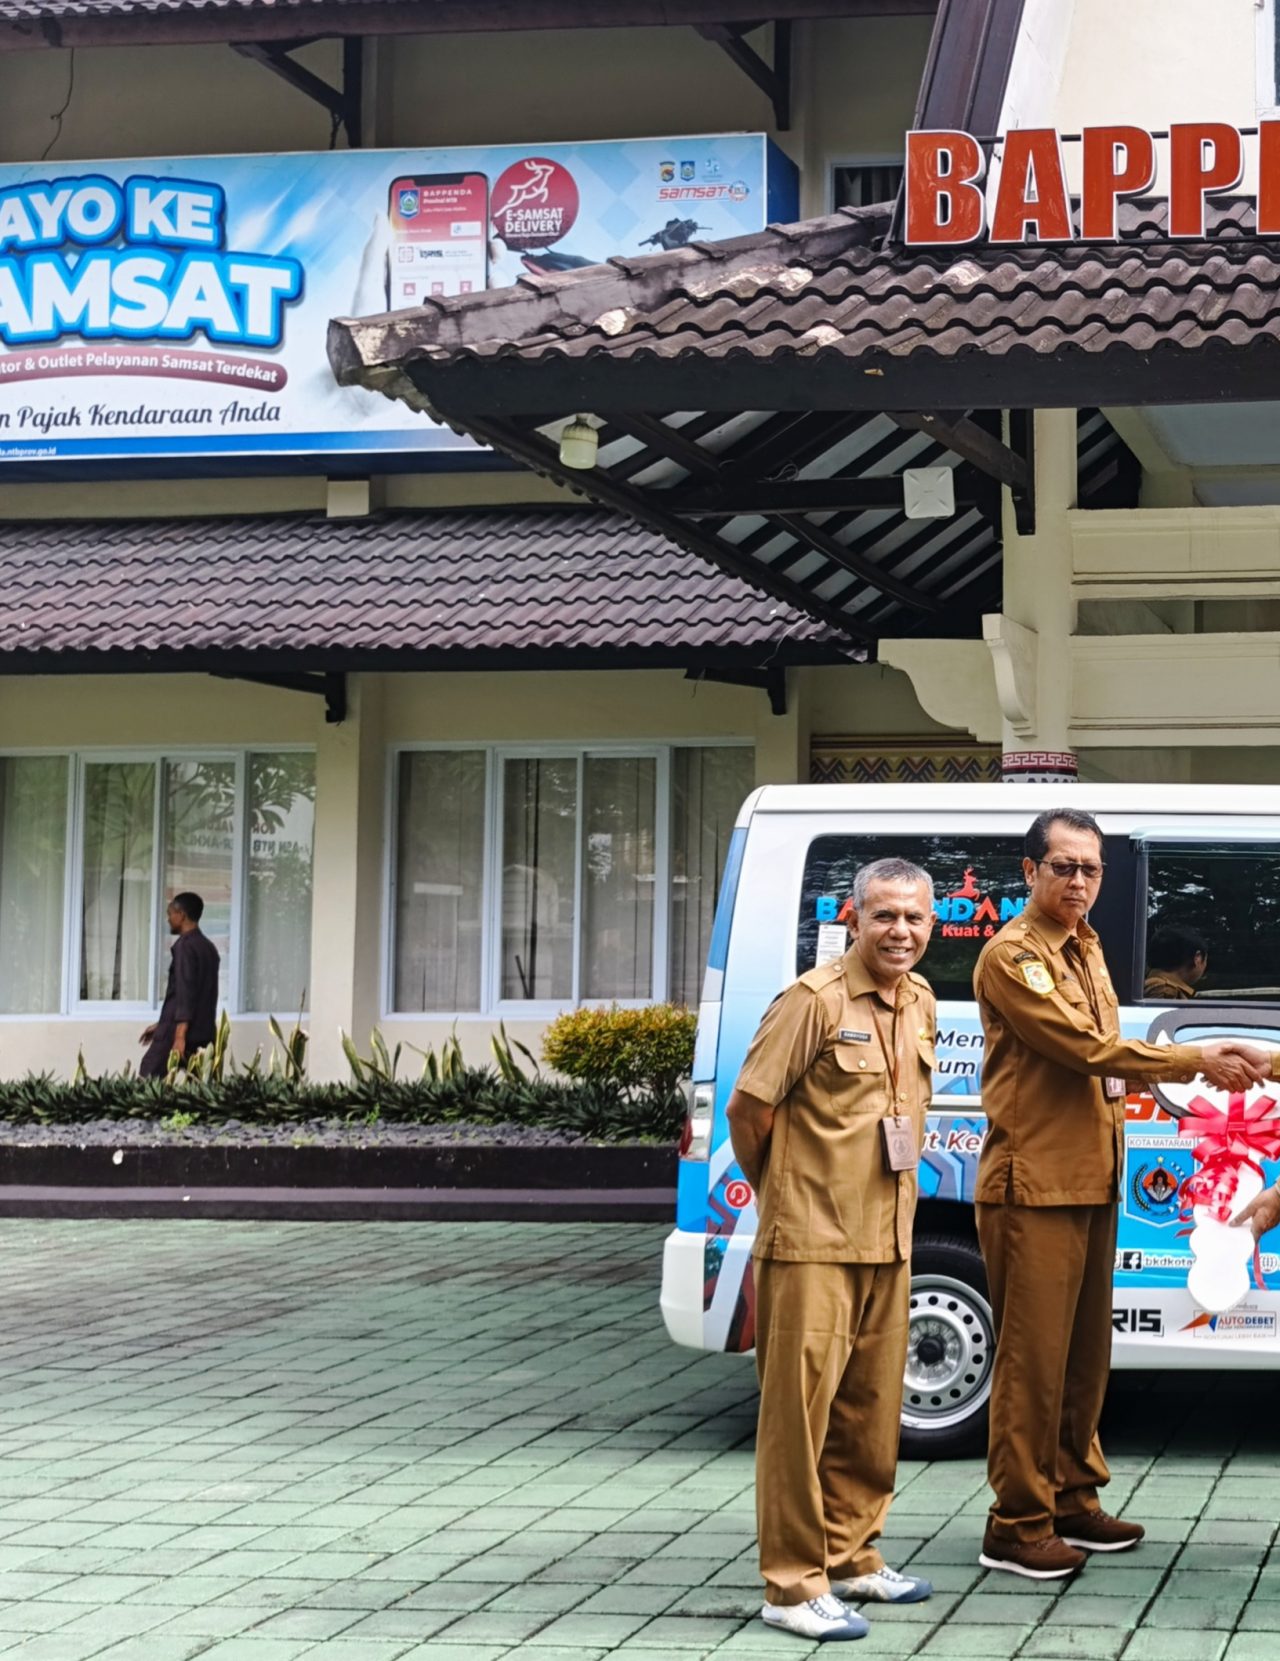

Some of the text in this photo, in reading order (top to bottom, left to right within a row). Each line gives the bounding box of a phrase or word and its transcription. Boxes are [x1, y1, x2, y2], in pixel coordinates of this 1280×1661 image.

[423, 188, 473, 197] BAPPENDA
[0, 186, 214, 243] AYO KE
[506, 207, 564, 221] E-SAMSAT
[504, 219, 563, 233] DELIVERY
[24, 358, 36, 371] &
[38, 354, 83, 369] Outlet
[86, 352, 159, 369] Pelayanan
[161, 354, 213, 373] Samsat
[215, 360, 278, 384] Terdekat
[17, 406, 81, 434] Pajak
[88, 403, 213, 426] Kendaraan
[219, 400, 281, 426] Anda
[941, 924, 996, 937] Kuat &
[1129, 1137, 1192, 1148] KOTA MATARAM
[1219, 1315, 1275, 1326] AUTODEBET
